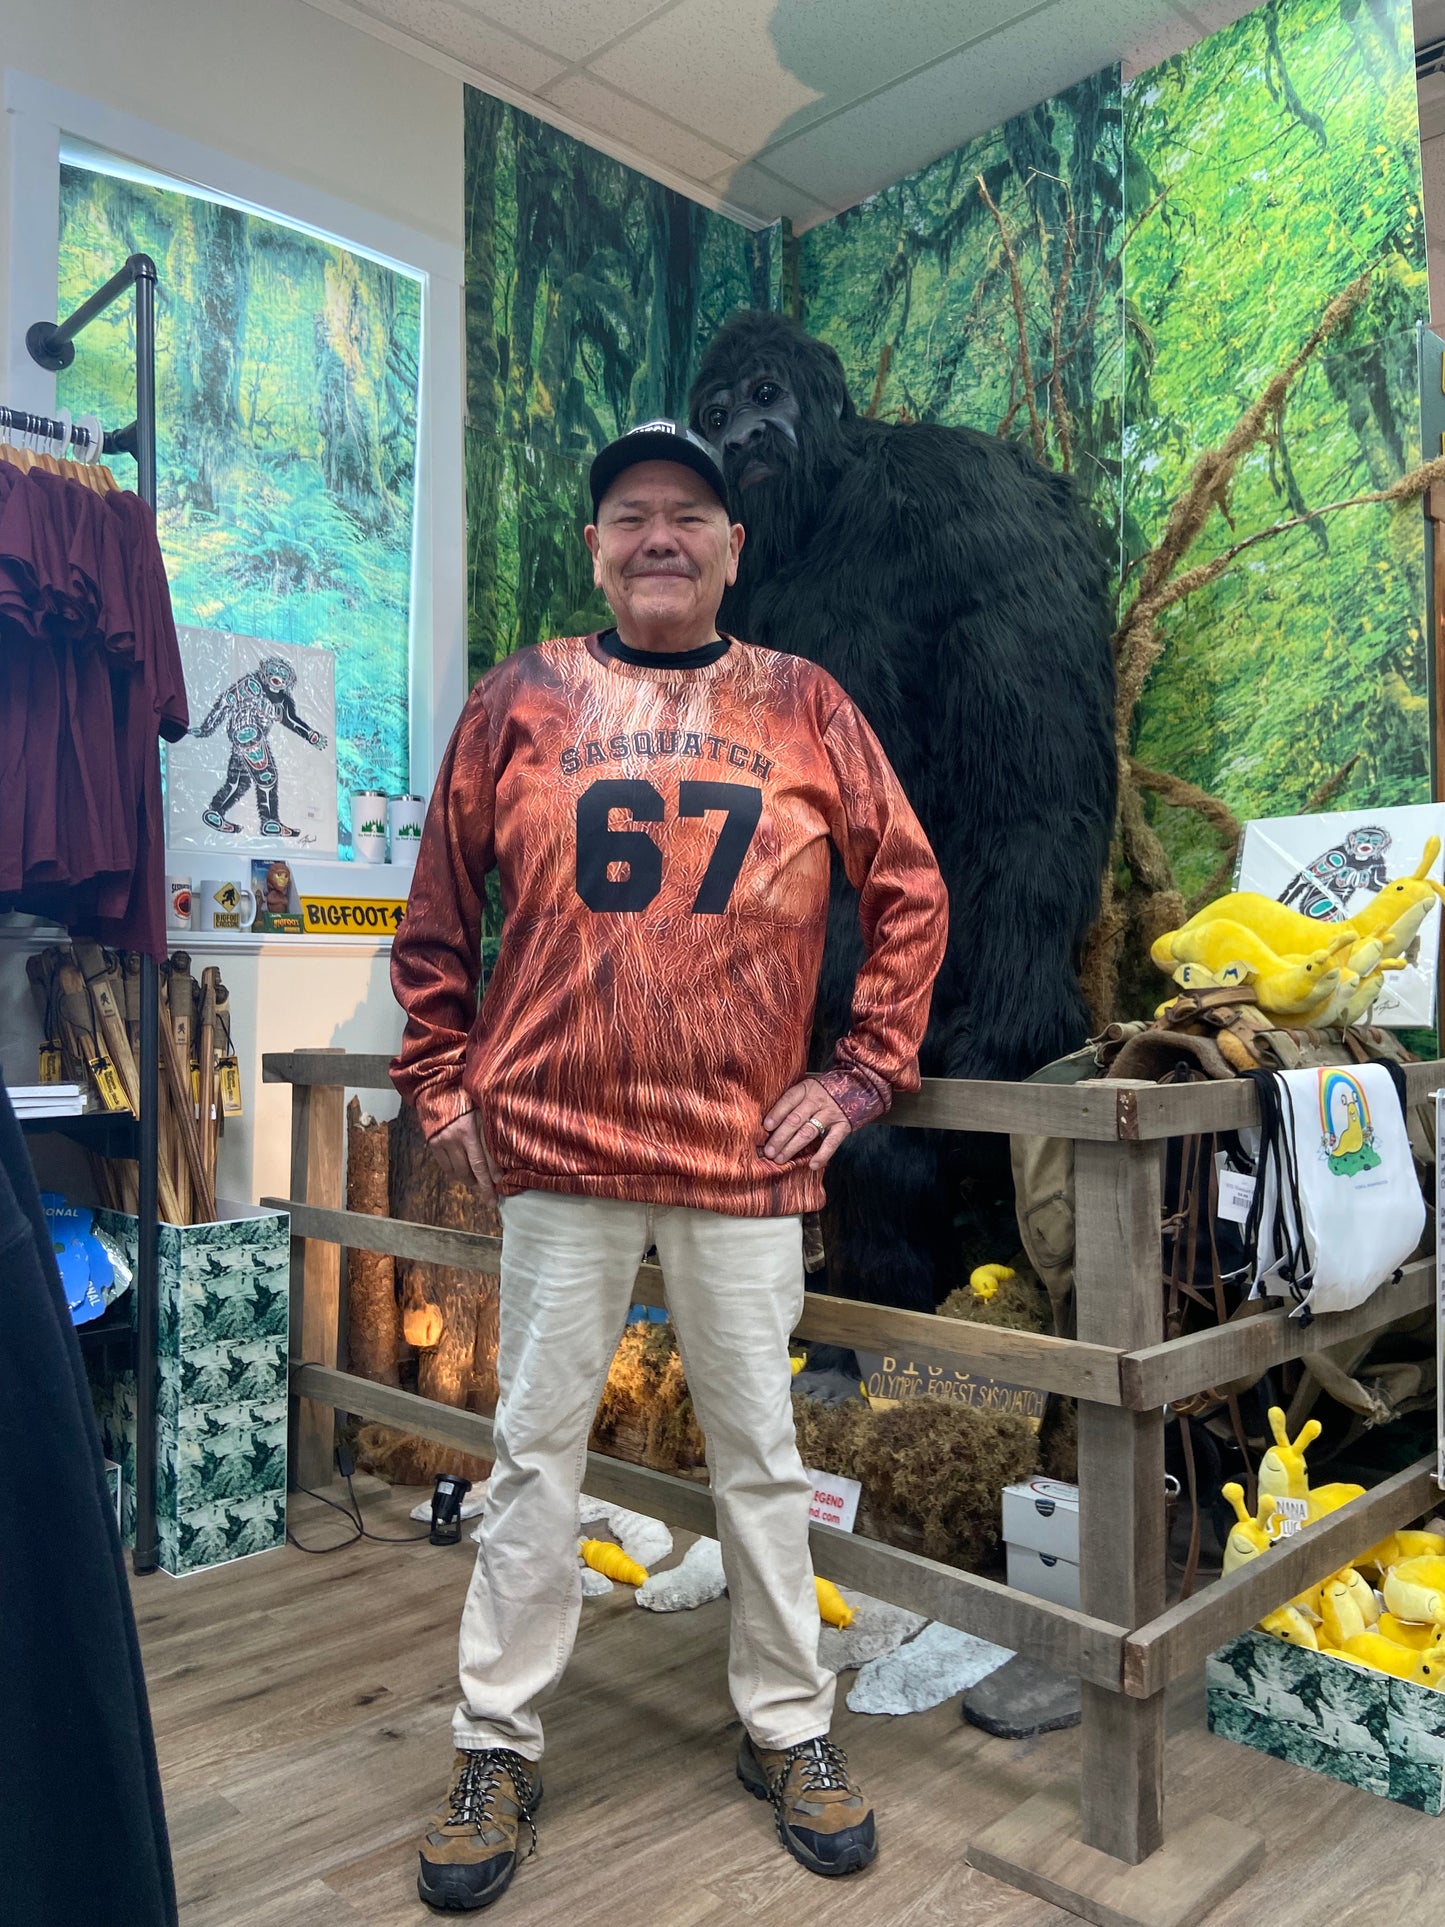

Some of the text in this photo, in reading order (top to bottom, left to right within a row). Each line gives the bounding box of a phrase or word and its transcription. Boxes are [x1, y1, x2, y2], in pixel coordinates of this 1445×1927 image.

[560, 729, 775, 781] SASQUATCH
[576, 779, 763, 916] 67
[306, 904, 389, 927] BIGFOOT
[1183, 967, 1191, 982] E
[868, 1372, 923, 1399] OLYMPIC
[814, 1490, 845, 1509] EGEND
